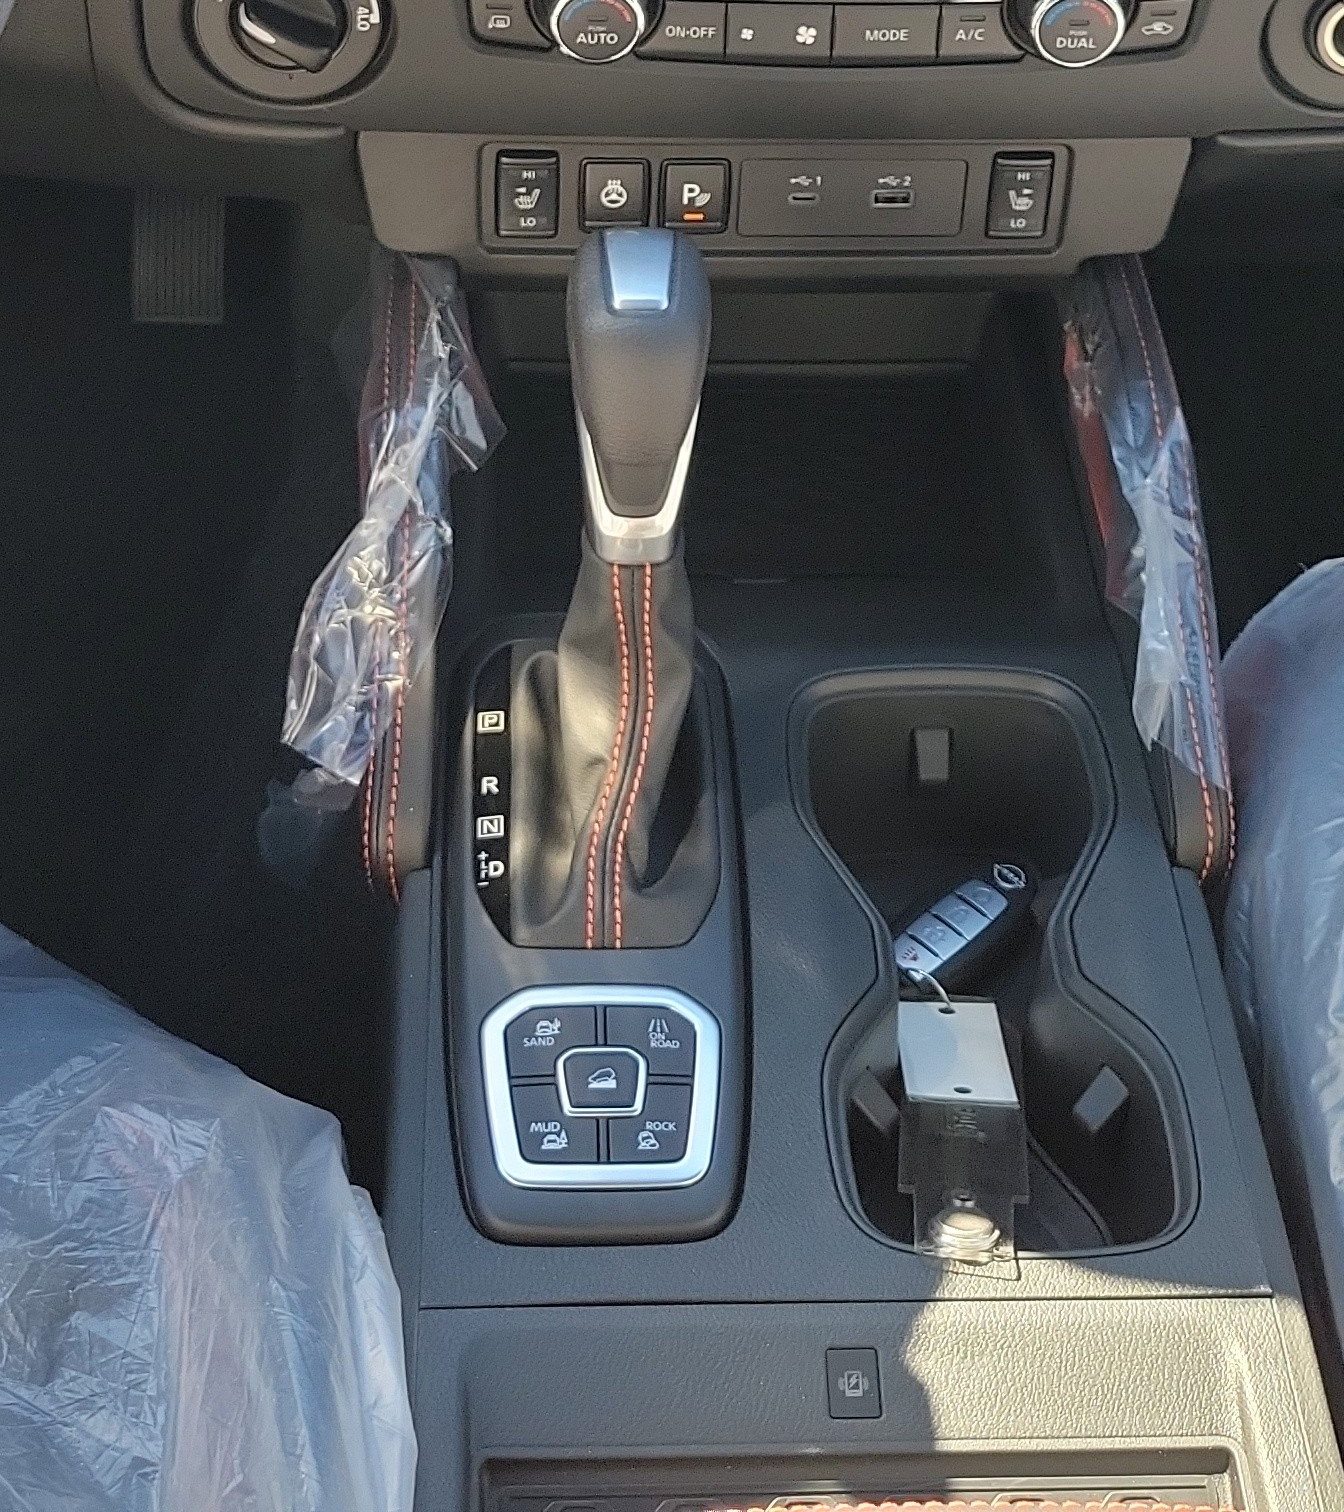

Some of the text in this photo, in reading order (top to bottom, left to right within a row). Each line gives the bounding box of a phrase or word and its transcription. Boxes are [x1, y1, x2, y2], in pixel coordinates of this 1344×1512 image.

[357, 6, 371, 32] 4LO
[576, 32, 619, 45] AUTO
[865, 29, 910, 42] MODE
[955, 28, 985, 42] A/C
[1056, 37, 1097, 49] DUAL
[521, 170, 536, 180] HI
[1017, 171, 1031, 181] HI
[519, 217, 536, 227] LO
[1010, 218, 1026, 228] LO
[480, 776, 499, 795] R
[482, 819, 498, 834] N
[488, 861, 505, 878] D
[649, 1032, 666, 1040] ON
[523, 1037, 555, 1047] SAND
[650, 1040, 680, 1048] ROAD
[529, 1122, 560, 1133] MUD
[645, 1122, 677, 1131] ROCK
